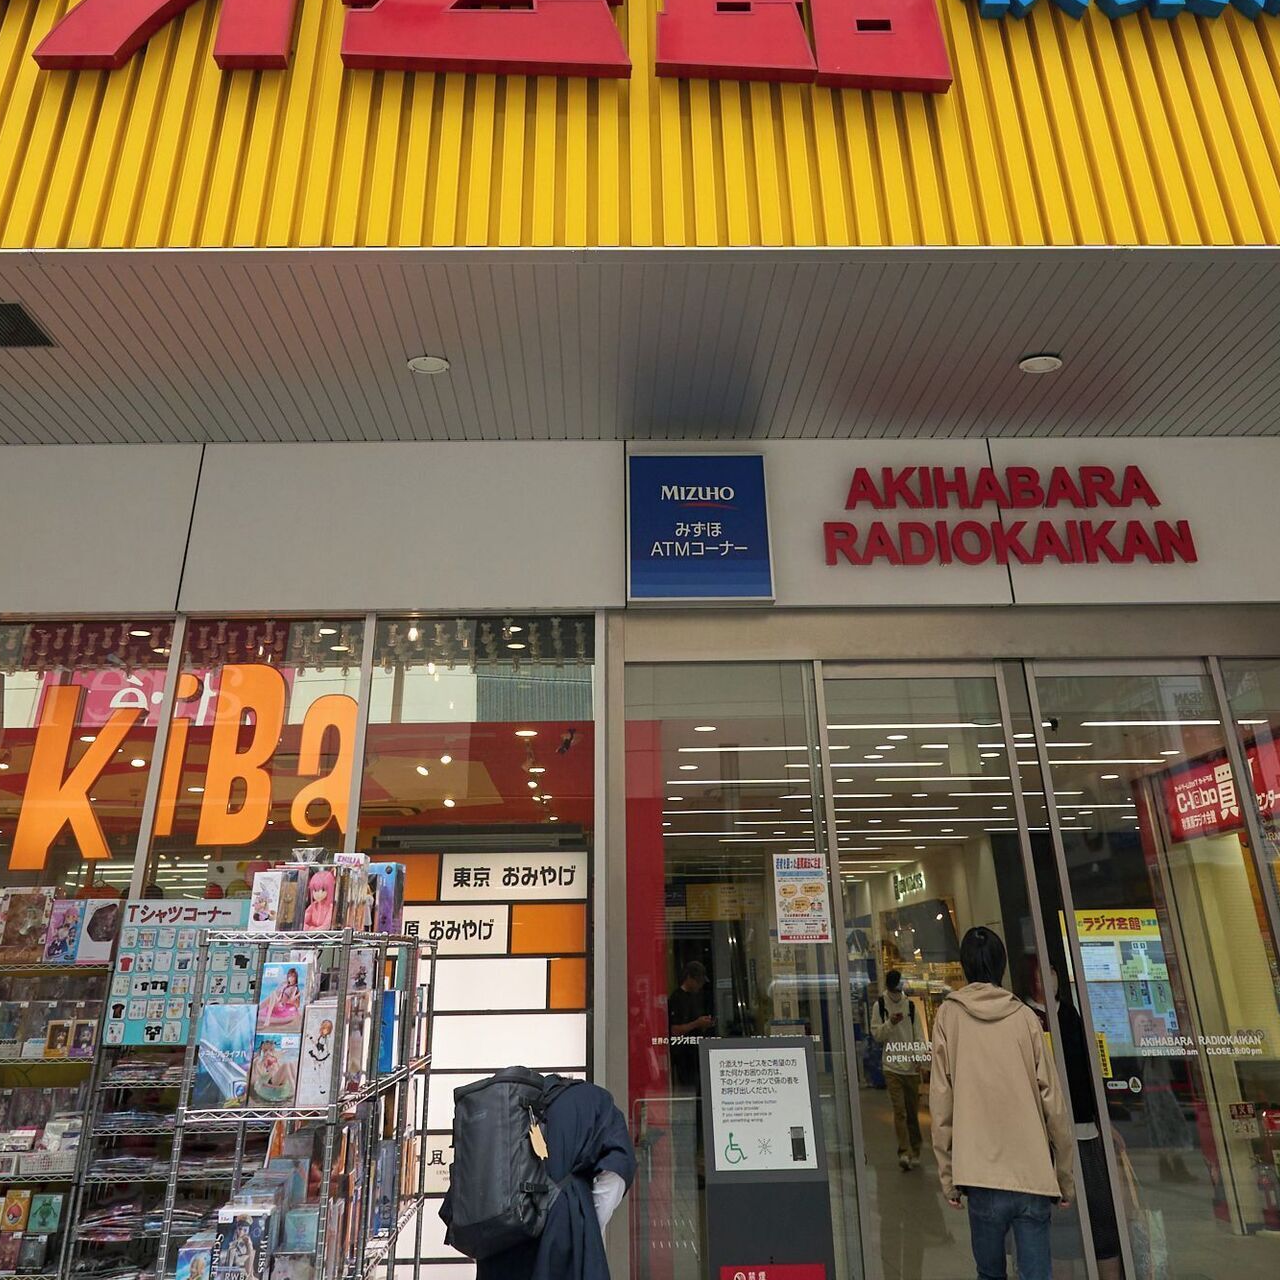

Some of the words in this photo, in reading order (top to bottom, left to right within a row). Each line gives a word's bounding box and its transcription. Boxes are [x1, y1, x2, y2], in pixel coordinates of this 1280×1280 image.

[660, 485, 735, 502] MIZUHO
[844, 464, 1161, 511] AKIHABARA
[674, 521, 723, 538] みずほ
[650, 540, 748, 558] ATMコーナー
[823, 519, 1199, 567] RADIOKAIKAN
[453, 867, 491, 887] 東京
[502, 865, 576, 888] おみやげ
[127, 903, 233, 925] Tシャツコーナー
[429, 919, 495, 942] おみやげ
[1139, 1036, 1194, 1048] AKIHABARA
[1198, 1035, 1262, 1047] RADIOKAIKAN
